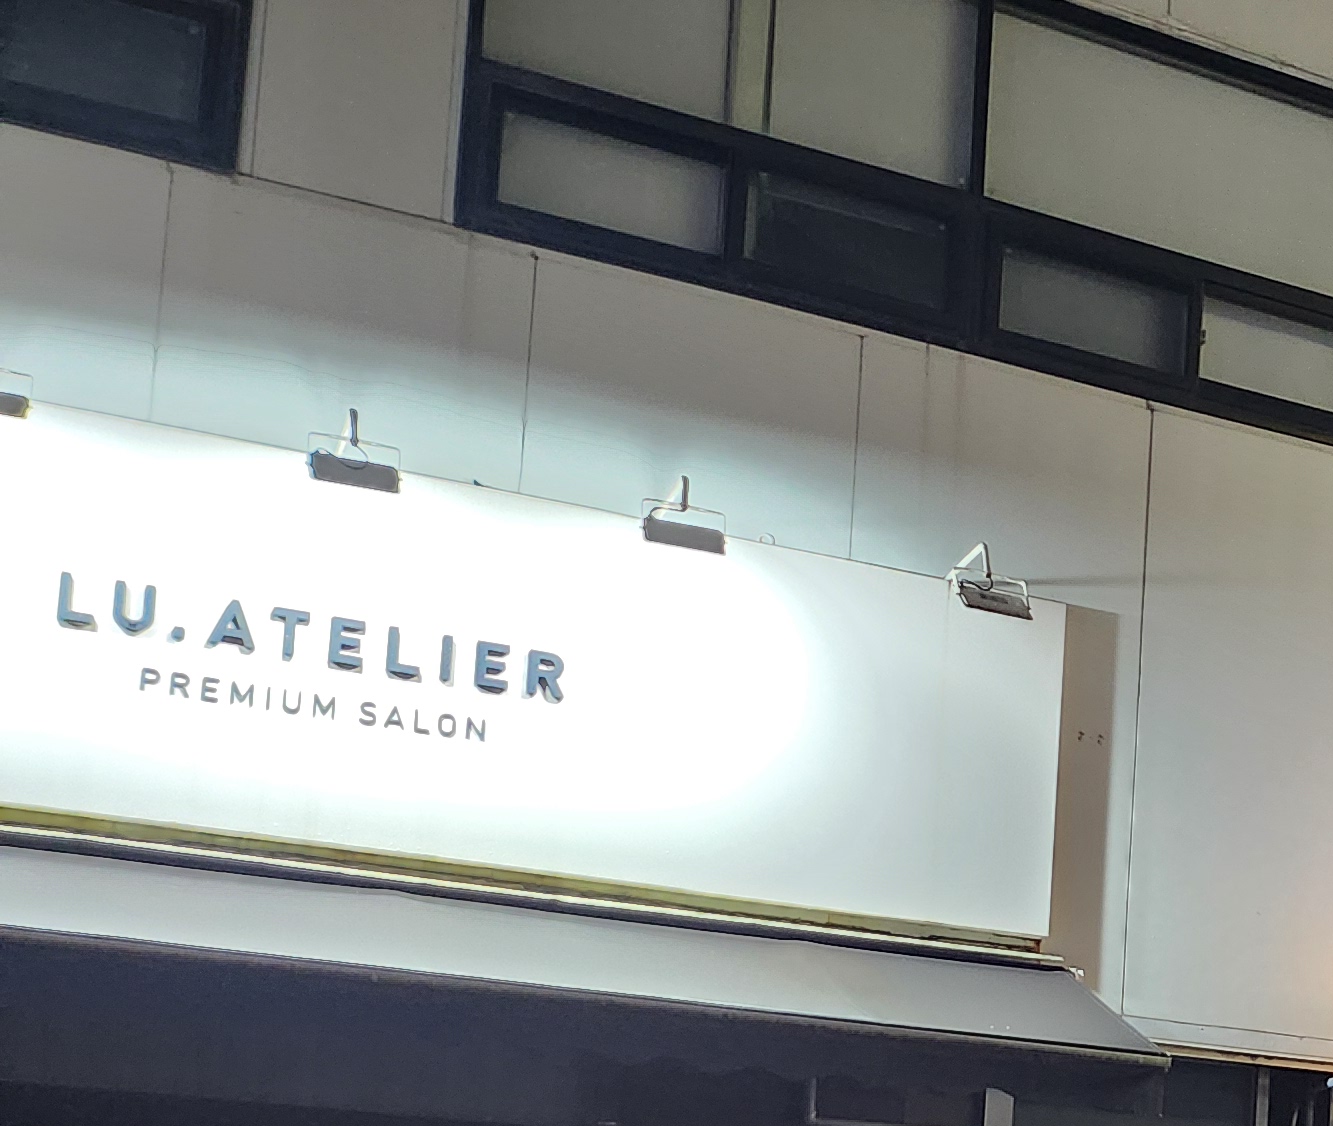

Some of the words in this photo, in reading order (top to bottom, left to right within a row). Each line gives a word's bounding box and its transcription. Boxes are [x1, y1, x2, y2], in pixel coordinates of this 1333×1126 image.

[56, 570, 566, 704] LU.ATELIER
[139, 666, 337, 721] PREMIUM
[358, 701, 488, 743] SALON
